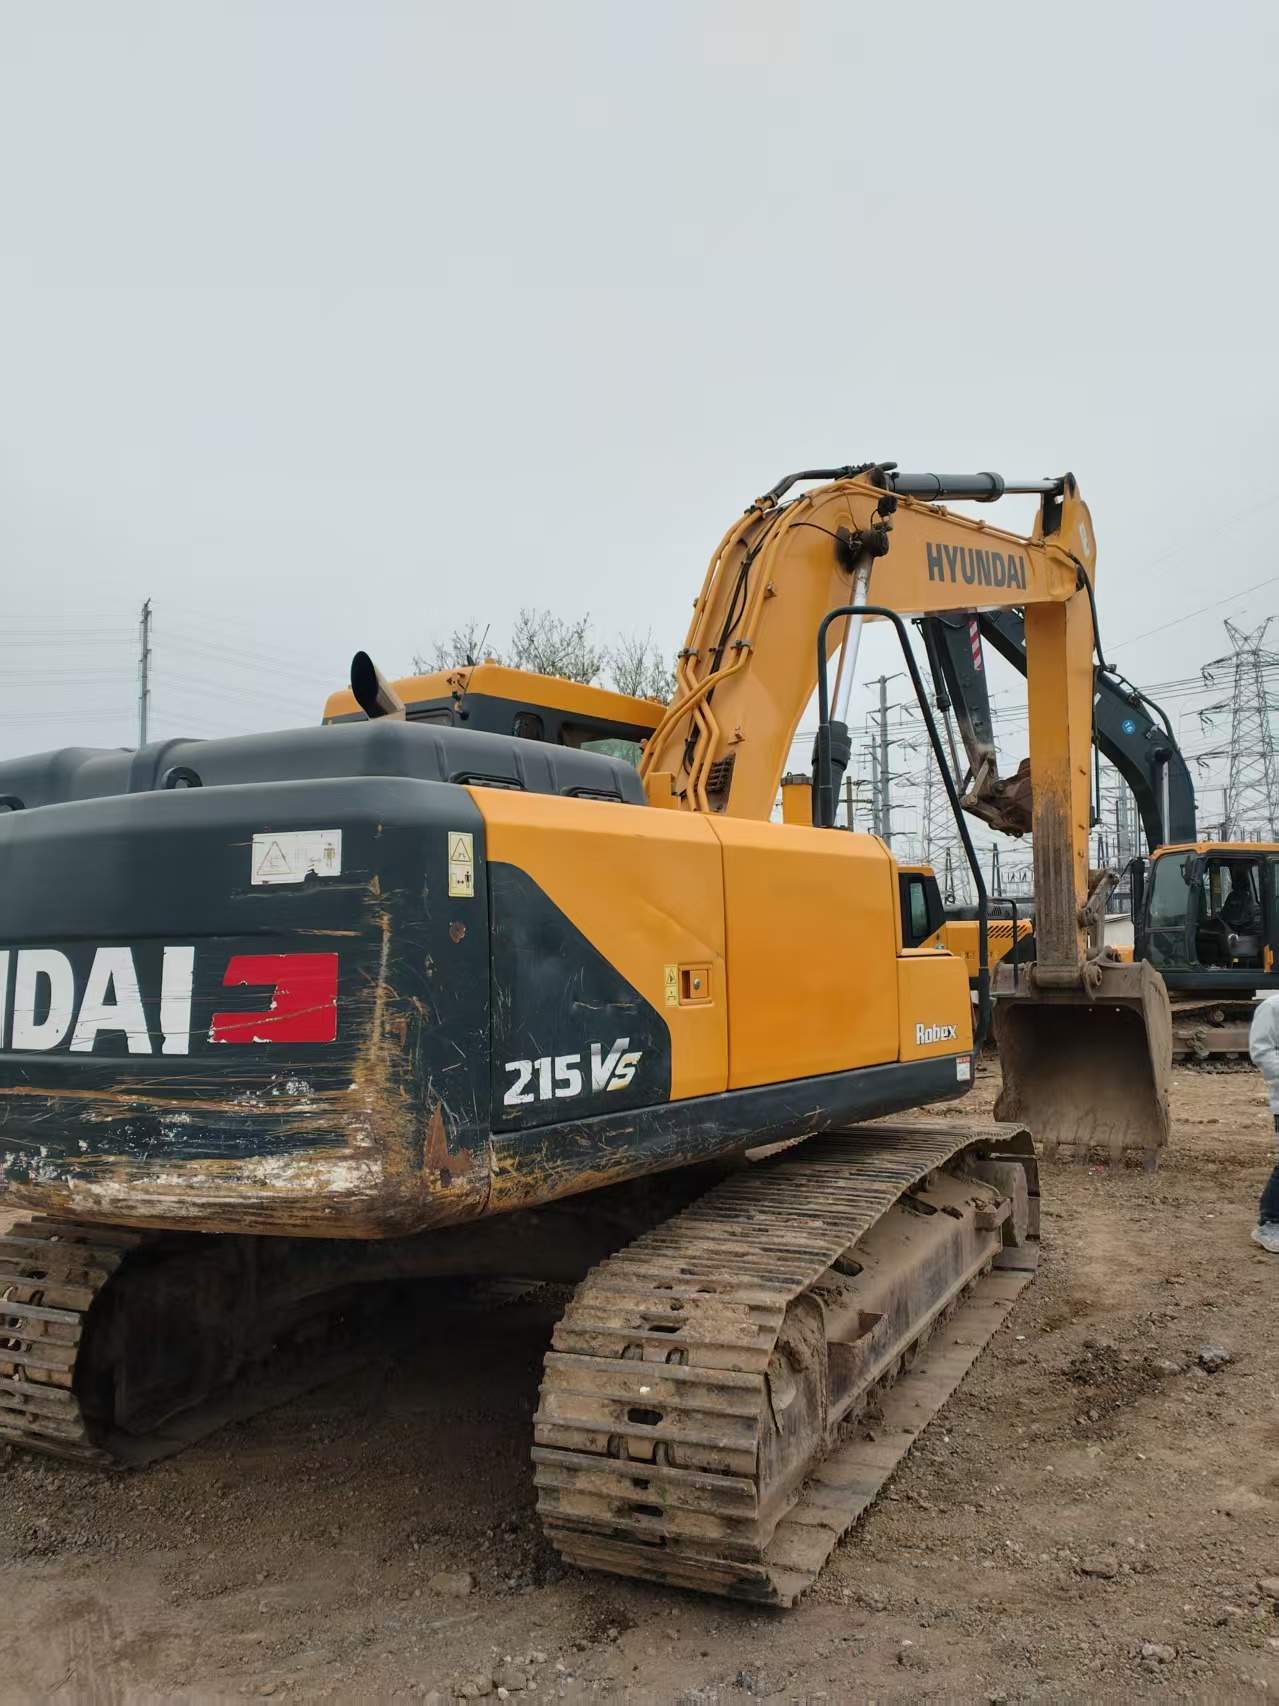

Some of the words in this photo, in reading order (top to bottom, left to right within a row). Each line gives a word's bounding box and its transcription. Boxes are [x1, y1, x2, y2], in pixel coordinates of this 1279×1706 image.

[926, 542, 1027, 590] HYUNDAI
[0, 946, 195, 1055] DAI
[915, 1023, 959, 1045] Robex
